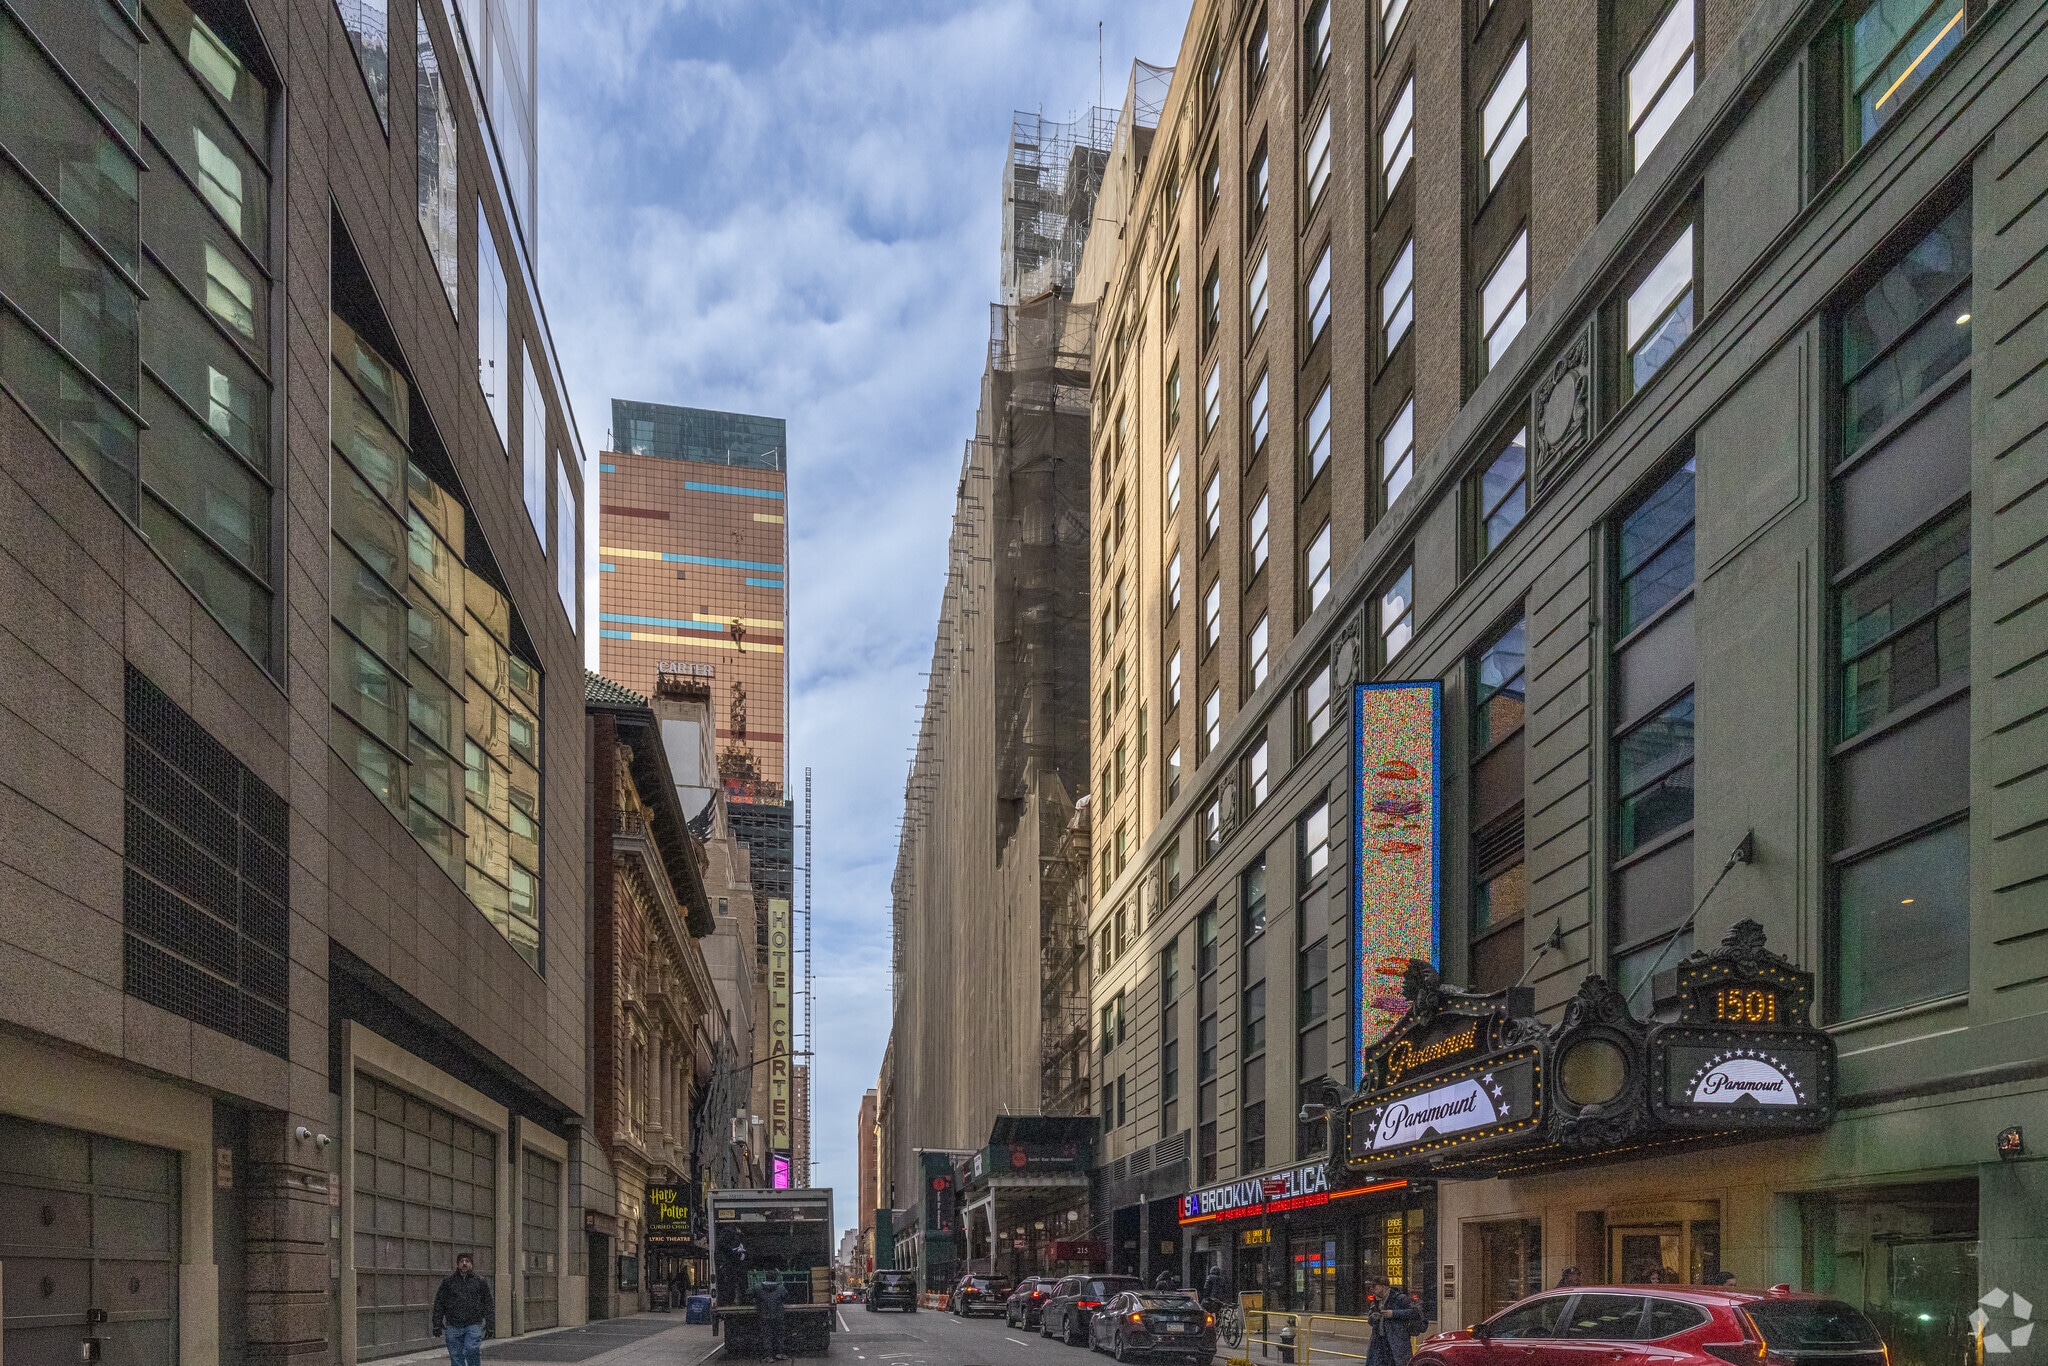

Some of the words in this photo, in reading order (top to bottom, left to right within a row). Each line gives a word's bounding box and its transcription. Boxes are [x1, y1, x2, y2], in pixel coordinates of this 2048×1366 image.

[657, 661, 715, 678] CARTER
[661, 679, 710, 694] HOTEL
[772, 911, 787, 1008] HOTEL
[1717, 988, 1775, 1022] 1501
[1385, 1020, 1478, 1086] Paramount
[772, 1019, 787, 1137] CARTER
[1703, 1072, 1784, 1095] Paramount
[1382, 1089, 1478, 1141] Paramount
[650, 1188, 678, 1206] Harry
[660, 1202, 689, 1221] Potter
[1178, 1194, 1199, 1218] USA
[1201, 1178, 1264, 1214] BROOKLYN
